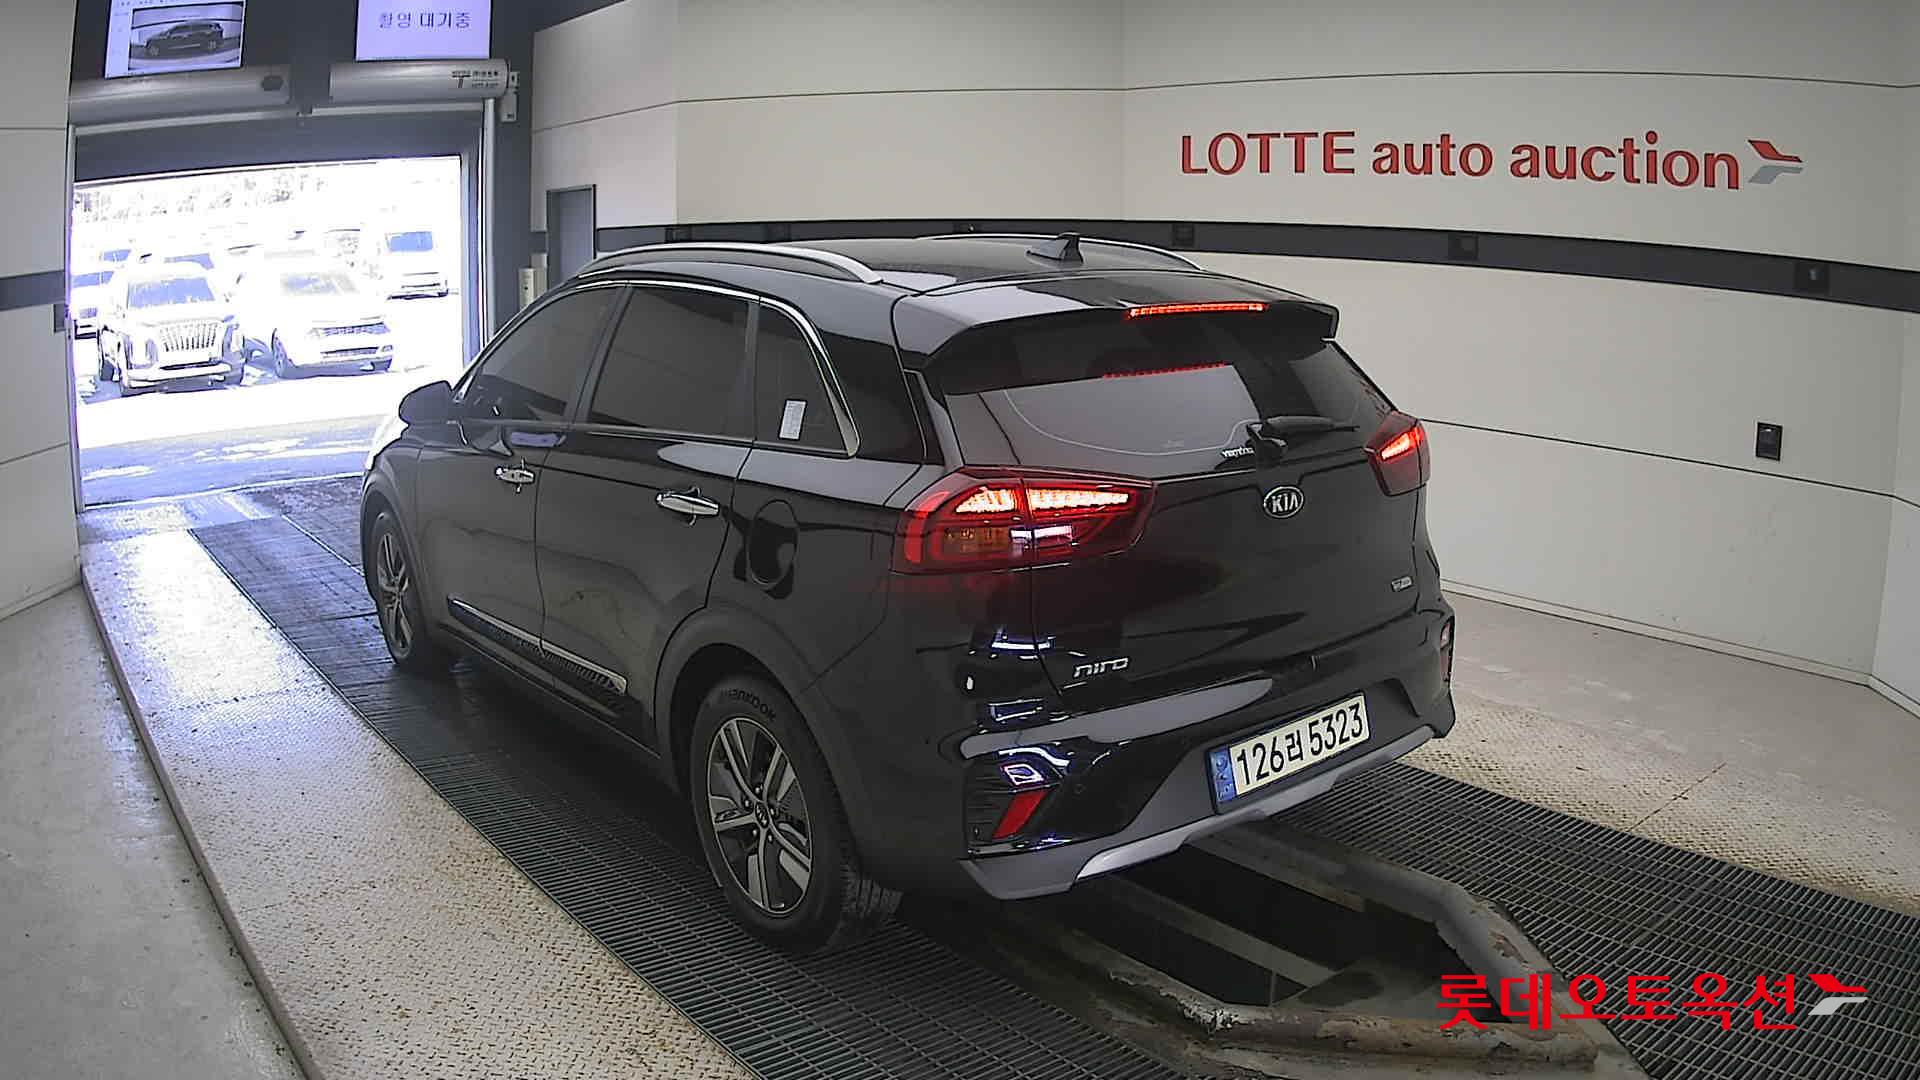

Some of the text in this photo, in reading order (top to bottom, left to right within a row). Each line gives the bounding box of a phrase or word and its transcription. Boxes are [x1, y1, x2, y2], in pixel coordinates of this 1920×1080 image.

[1181, 131, 1741, 190] LOTTE auto auction
[1271, 492, 1299, 513] KIA
[1307, 701, 1364, 756] 5323
